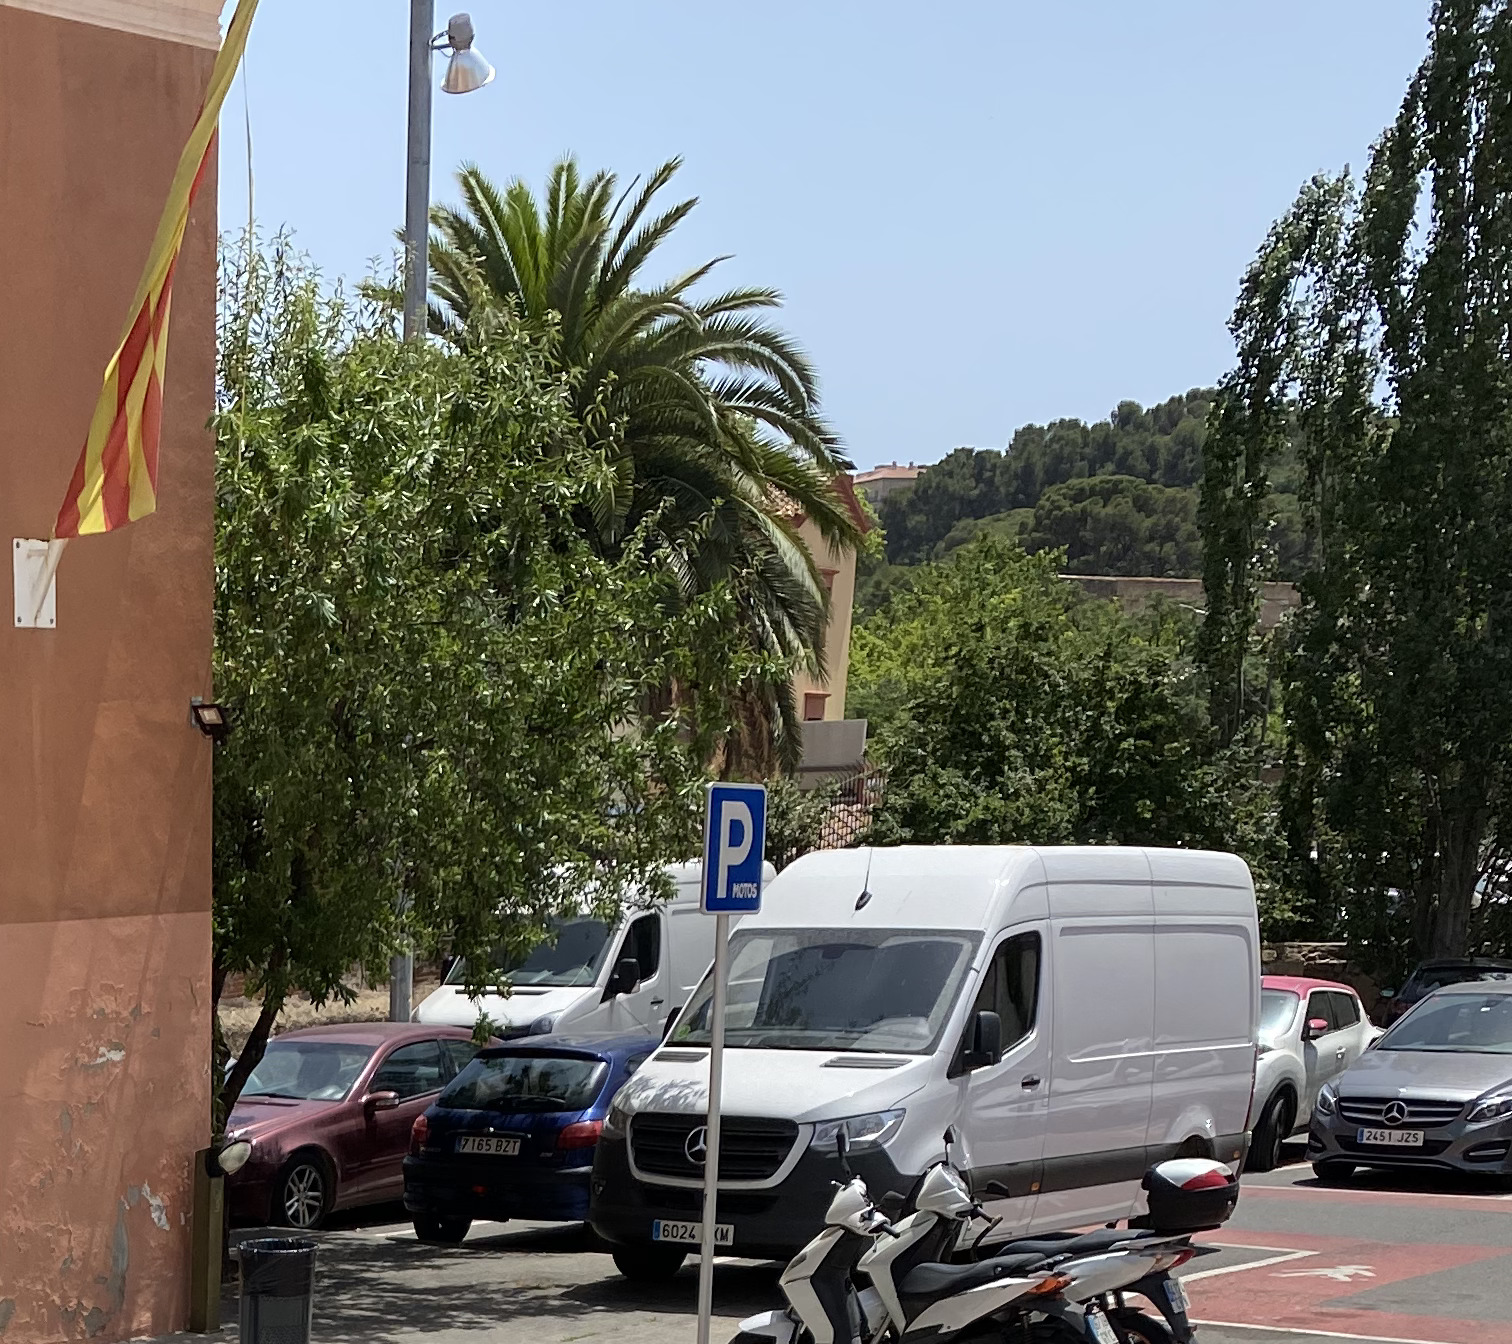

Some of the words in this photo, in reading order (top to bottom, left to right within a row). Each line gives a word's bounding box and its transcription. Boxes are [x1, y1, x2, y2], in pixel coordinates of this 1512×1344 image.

[716, 800, 754, 899] P
[732, 882, 758, 899] MOTOS
[1365, 1130, 1392, 1143] 2451
[1396, 1132, 1419, 1143] JZS
[461, 1138, 492, 1152] 7165
[495, 1139, 519, 1154] BZT
[662, 1223, 696, 1241] 6024
